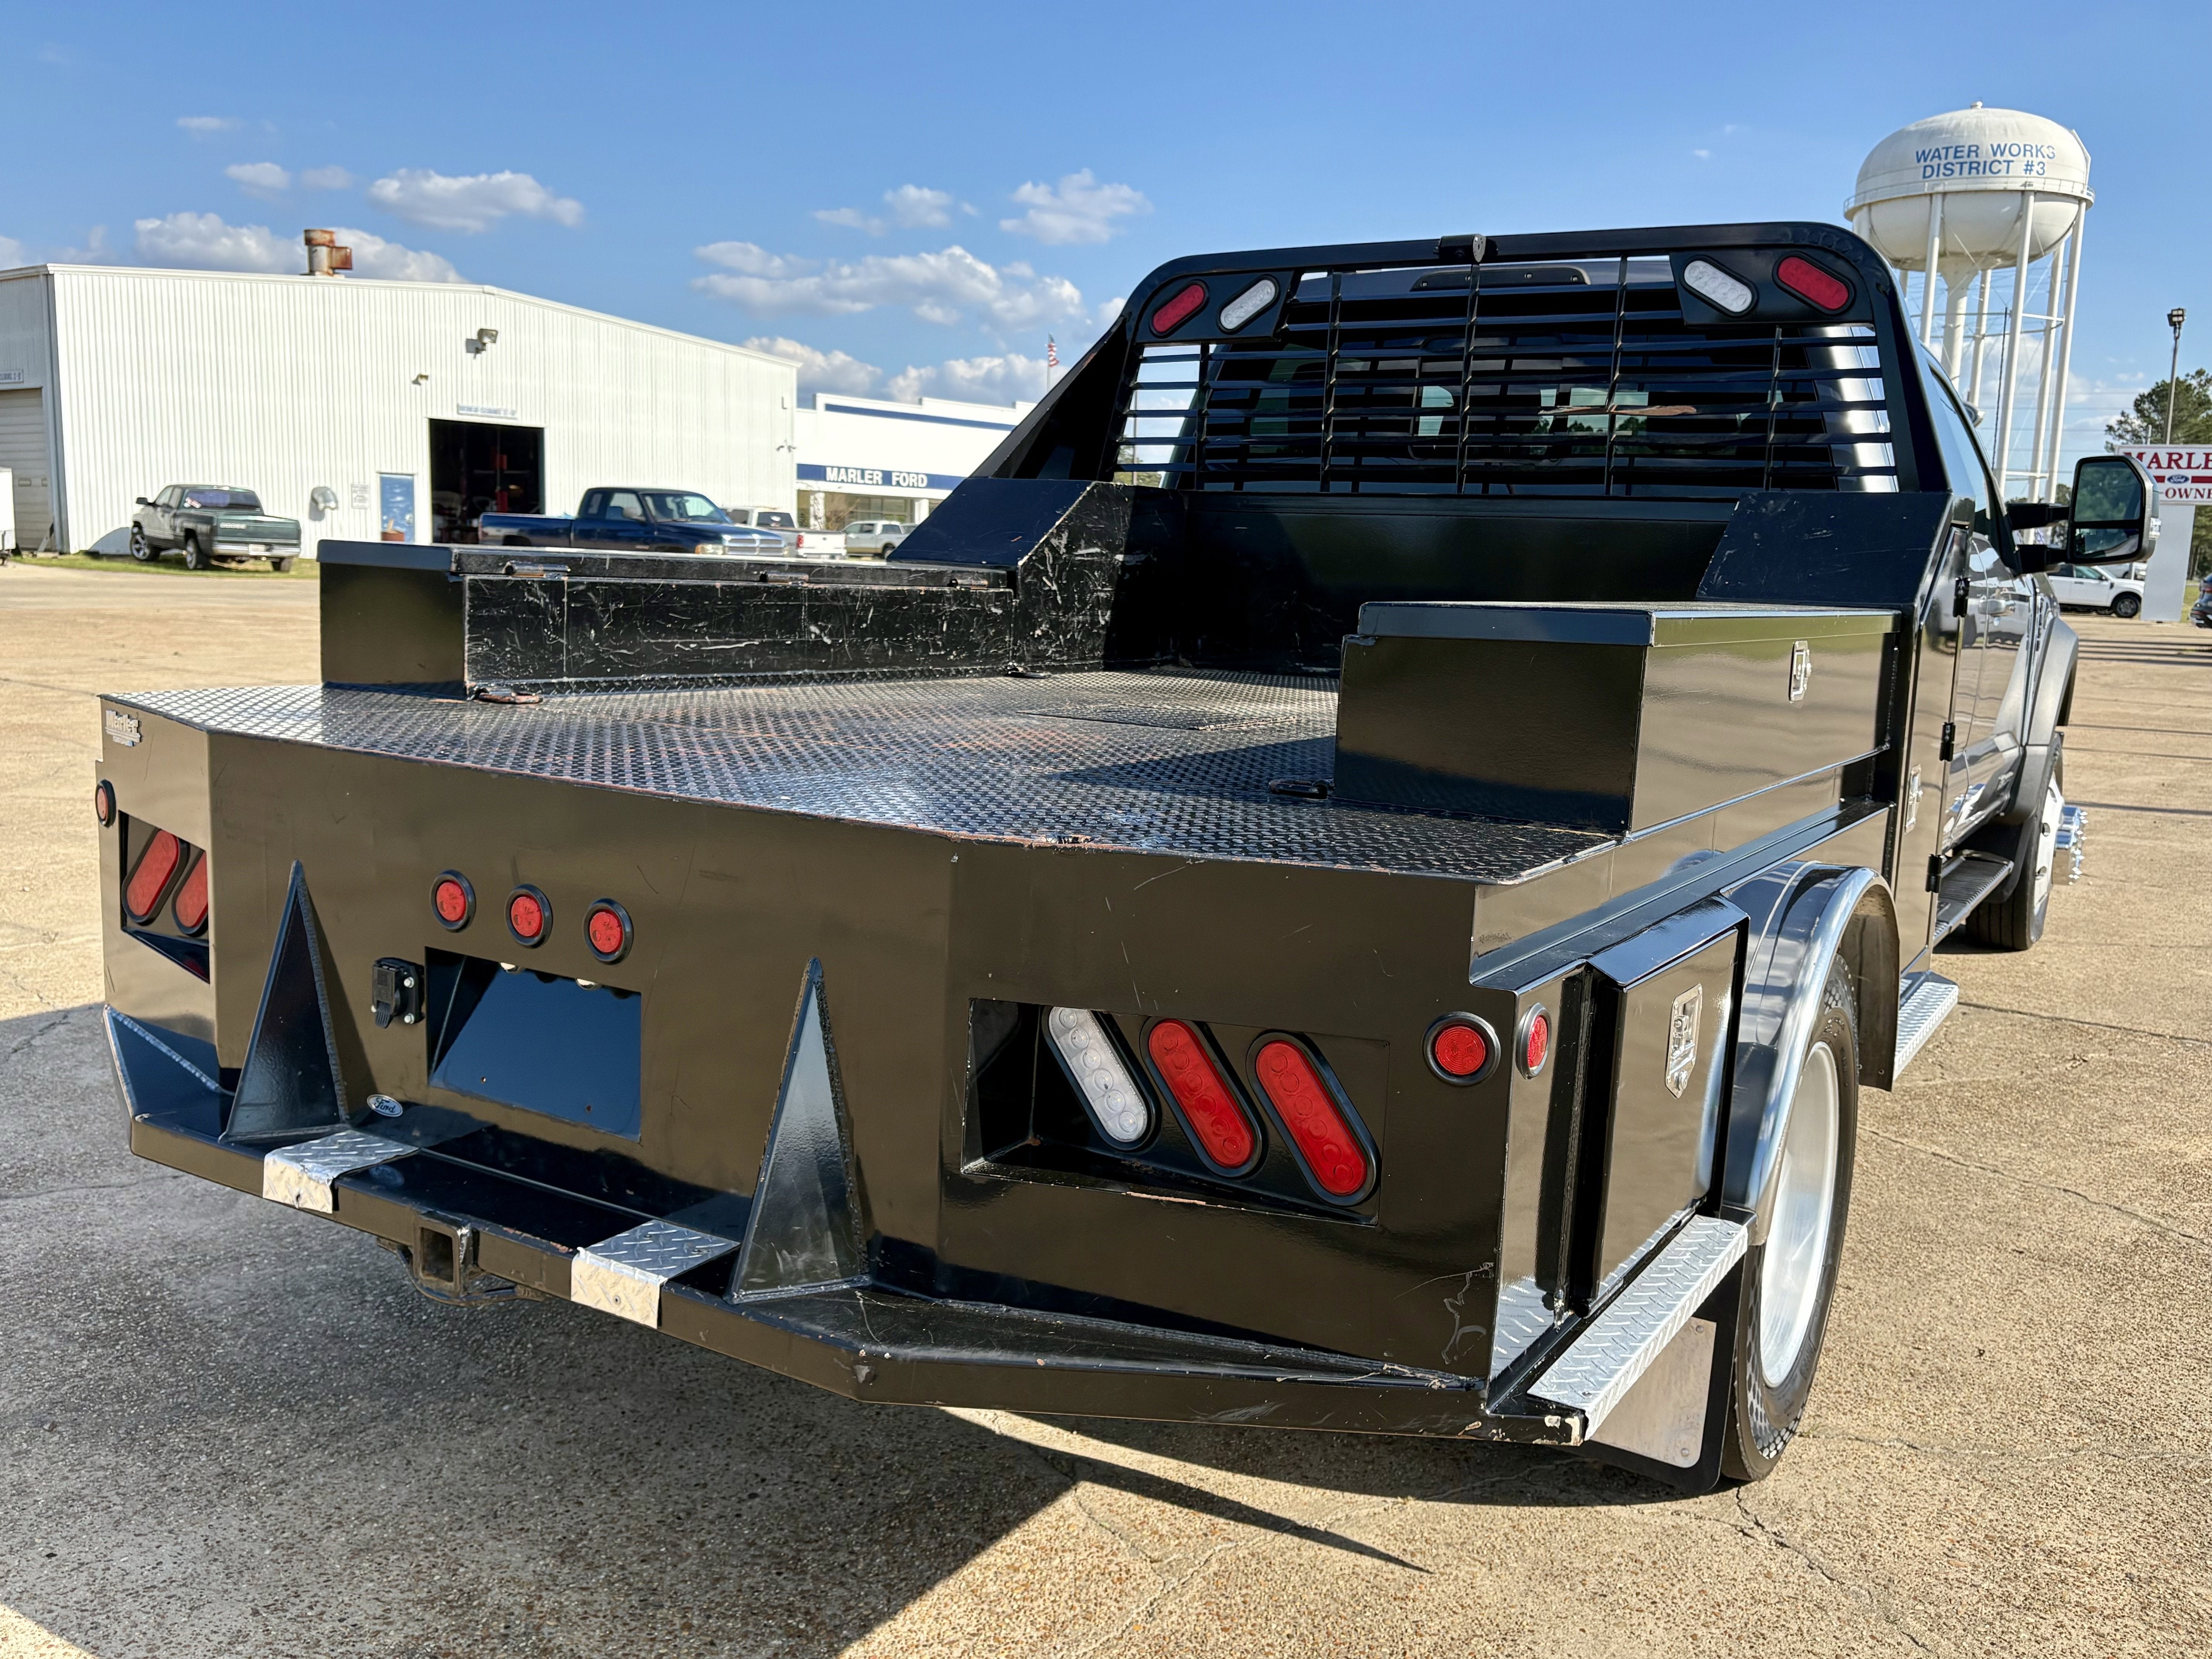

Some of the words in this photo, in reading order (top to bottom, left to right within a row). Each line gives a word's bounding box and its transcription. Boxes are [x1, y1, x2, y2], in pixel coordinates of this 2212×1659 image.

[1916, 144, 1980, 163] WATER
[1990, 143, 2056, 160] WORKS
[1922, 159, 2014, 179] DISTRICT
[2023, 160, 2045, 176] #3
[826, 467, 883, 485] MARLER
[891, 472, 927, 488] FORD
